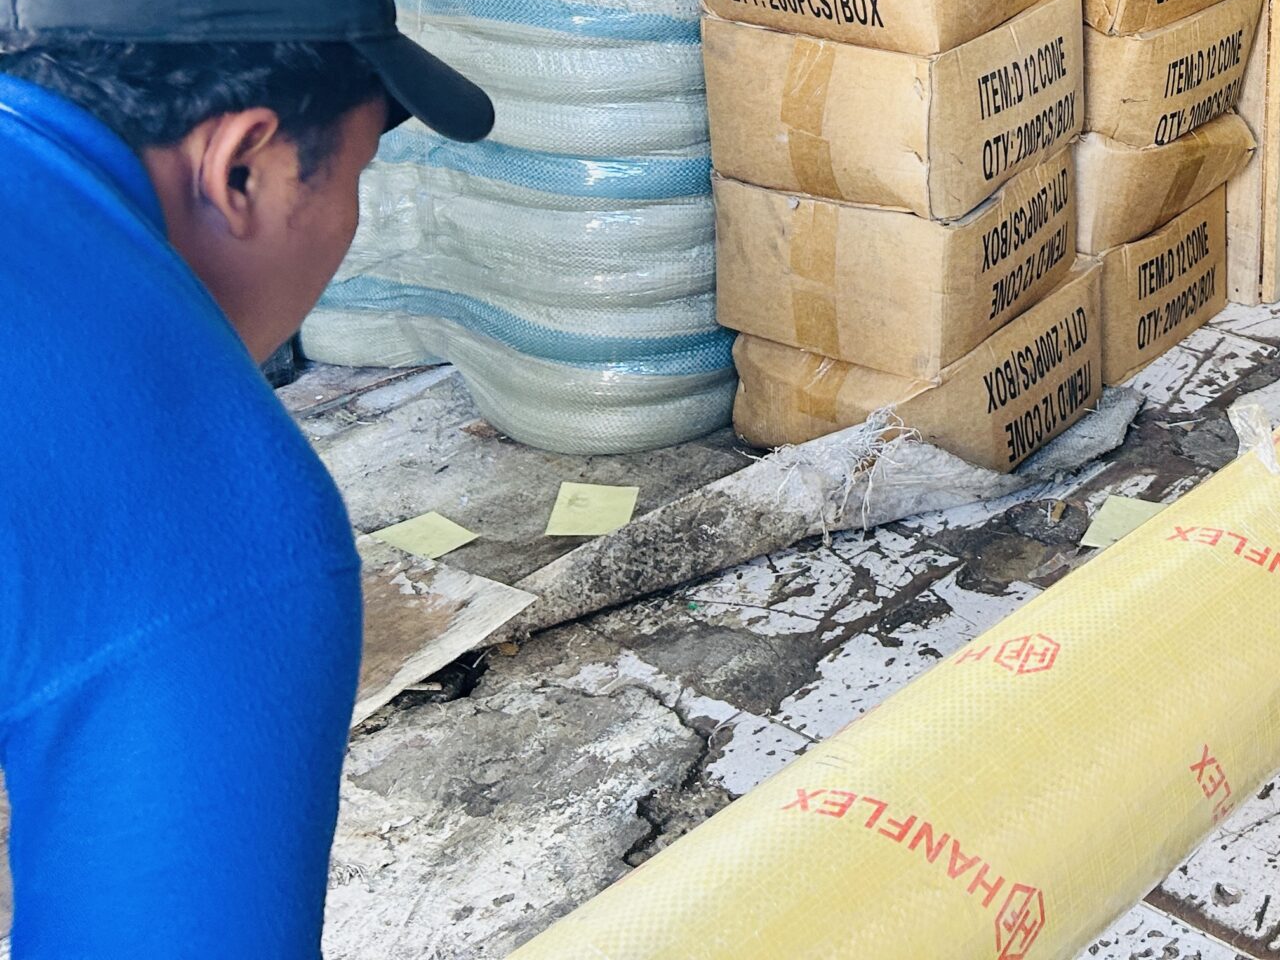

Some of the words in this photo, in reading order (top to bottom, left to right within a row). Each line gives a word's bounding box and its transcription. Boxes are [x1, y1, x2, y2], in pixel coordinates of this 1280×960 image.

[978, 61, 1024, 120] ITEM:D
[1024, 54, 1038, 97] 12
[1037, 36, 1067, 89] CONE
[1164, 50, 1204, 98] ITEM:D
[1206, 45, 1217, 79] 12
[1216, 29, 1243, 73] CONE
[982, 130, 1014, 181] QTY:
[1014, 91, 1076, 164] 200PCS/BOX
[1048, 168, 1069, 217] QTY:
[982, 186, 1049, 273] 200PCS/BOX
[1036, 222, 1069, 276] ITEM:D
[1138, 248, 1174, 300] ITEM:D
[1176, 241, 1187, 277] 12
[1186, 221, 1209, 268] CONE
[990, 264, 1023, 320] CONE
[1023, 252, 1035, 287] 12
[1060, 306, 1088, 356] QTY:
[1137, 306, 1163, 351] QTY:
[1163, 264, 1217, 334] 200PCS/BOX
[983, 325, 1062, 414] 200PCS/BOX
[1058, 360, 1092, 421] ITEM:D
[1005, 404, 1043, 463] CONE
[1042, 392, 1057, 434] 12
[781, 788, 1006, 908] HANFLEX
